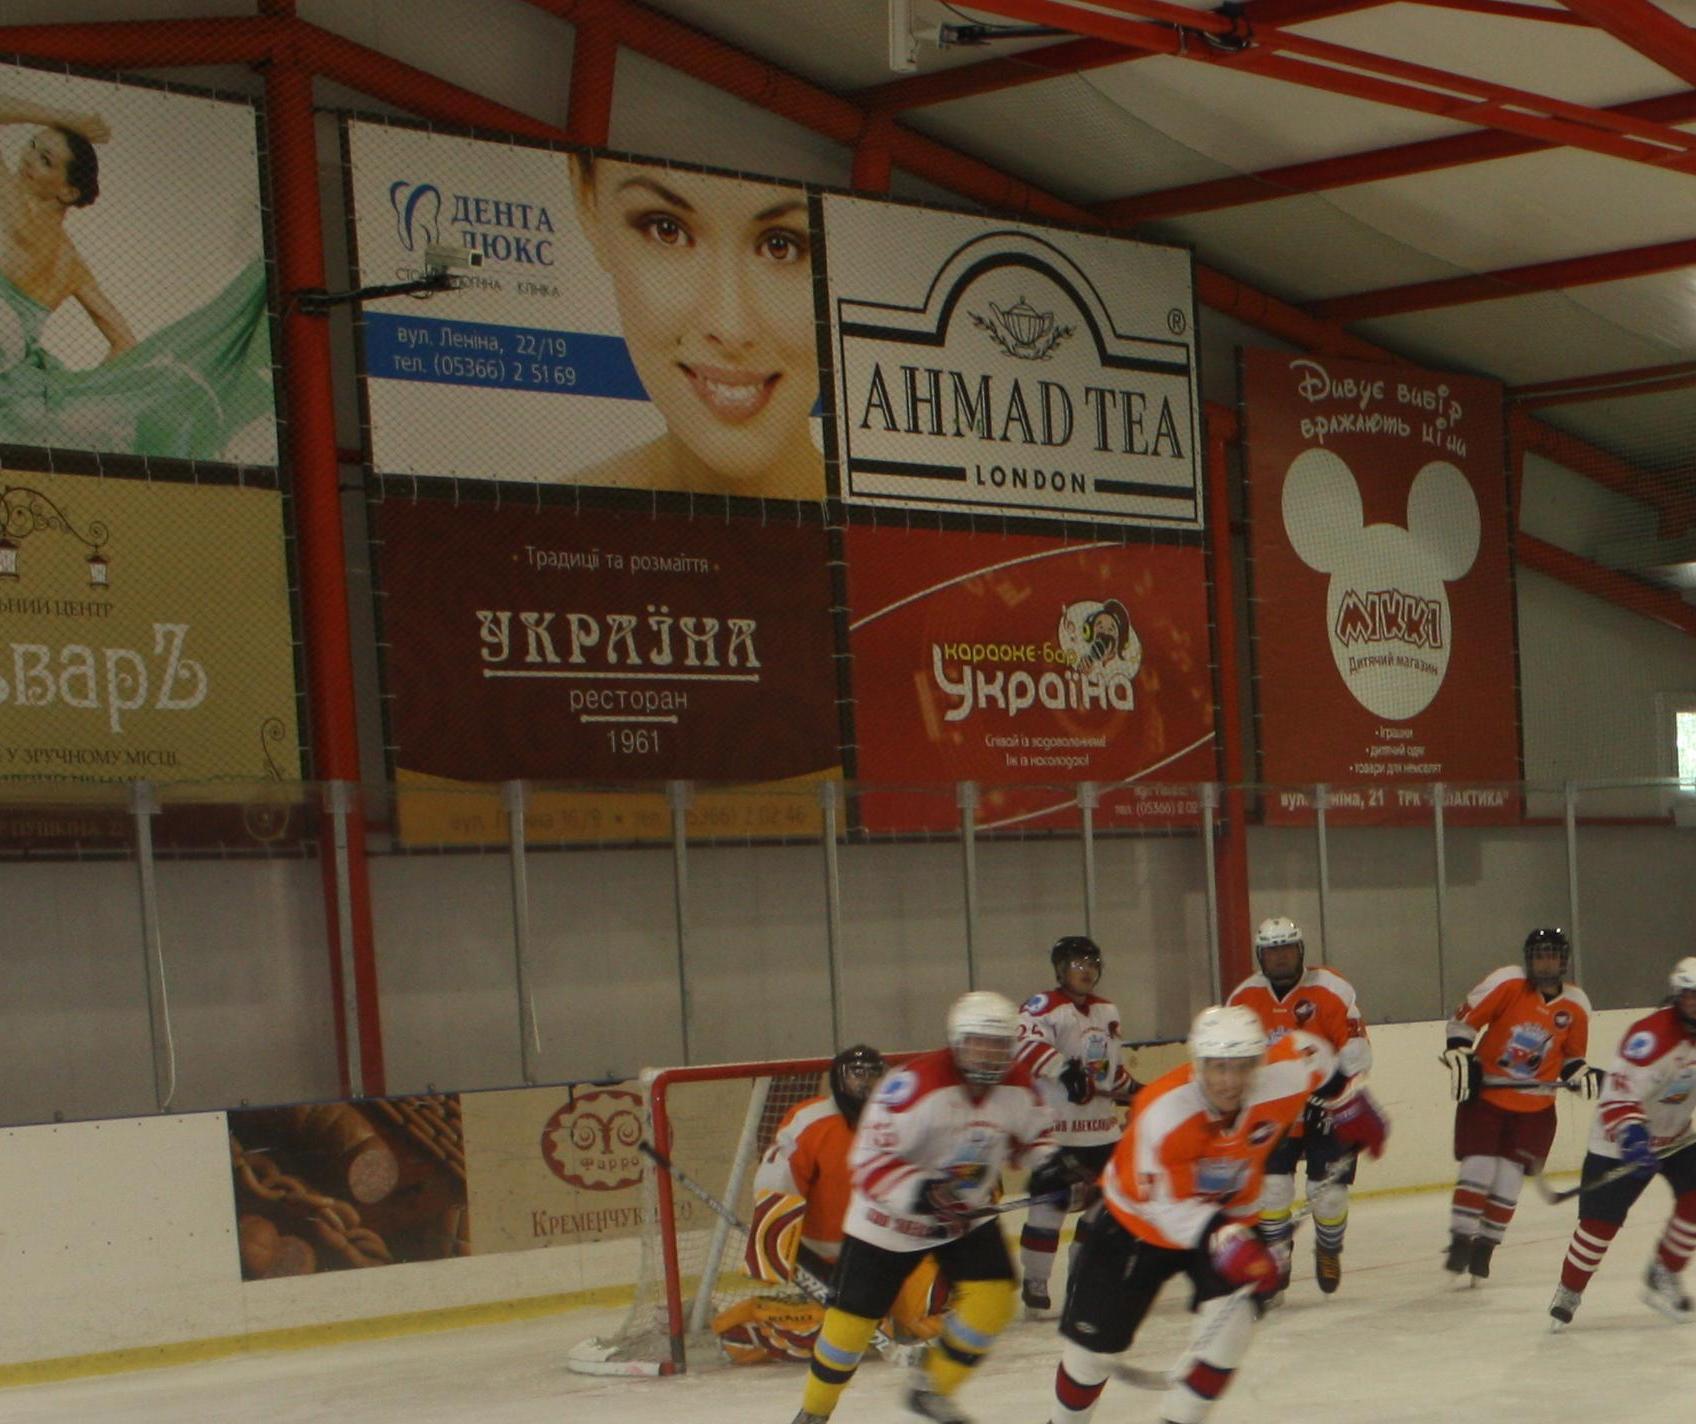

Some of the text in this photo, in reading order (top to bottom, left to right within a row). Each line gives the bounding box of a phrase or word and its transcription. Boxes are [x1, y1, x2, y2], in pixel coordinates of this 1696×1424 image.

[451, 194, 555, 232] ДЕНТА
[397, 327, 567, 361] вул. Леніна, 22/19
[394, 355, 427, 373] тел.
[433, 353, 505, 382] (05366)
[513, 362, 523, 382] 2
[1288, 359, 1385, 408] Дивує
[859, 362, 1185, 459] AHMAD TEA
[975, 464, 1086, 494] LONDON
[524, 545, 709, 575] Традиції та розмаїття
[55, 601, 113, 617] ЦЕНТР
[475, 605, 762, 669] УКРАЇНА
[1349, 653, 1439, 676] Дитячий магазин
[933, 643, 1135, 721] Україна
[569, 689, 688, 711] ресторан
[6, 749, 23, 763] У
[606, 730, 660, 754] 1961
[1368, 788, 1384, 806] 21
[1397, 789, 1421, 805] ТРК
